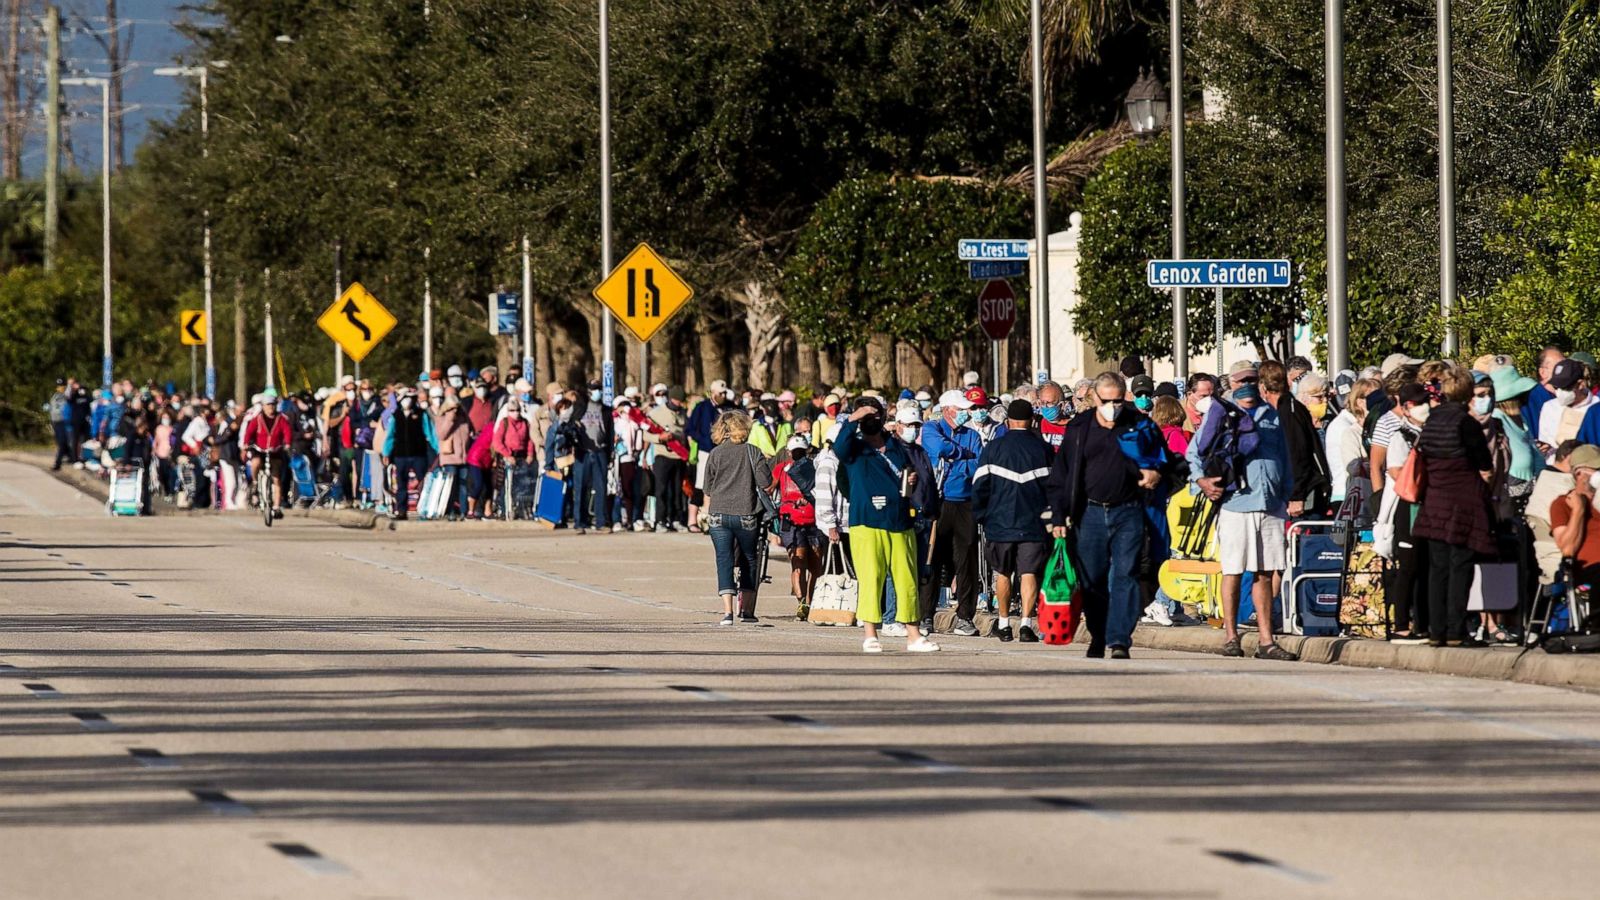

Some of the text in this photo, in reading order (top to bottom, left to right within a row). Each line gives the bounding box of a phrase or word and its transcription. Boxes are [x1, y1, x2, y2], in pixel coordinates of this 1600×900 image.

[960, 242, 978, 257] Sea
[981, 242, 1008, 257] Crest
[1150, 262, 1287, 284] Lenox Garden Ln
[982, 297, 1014, 321] STOP
